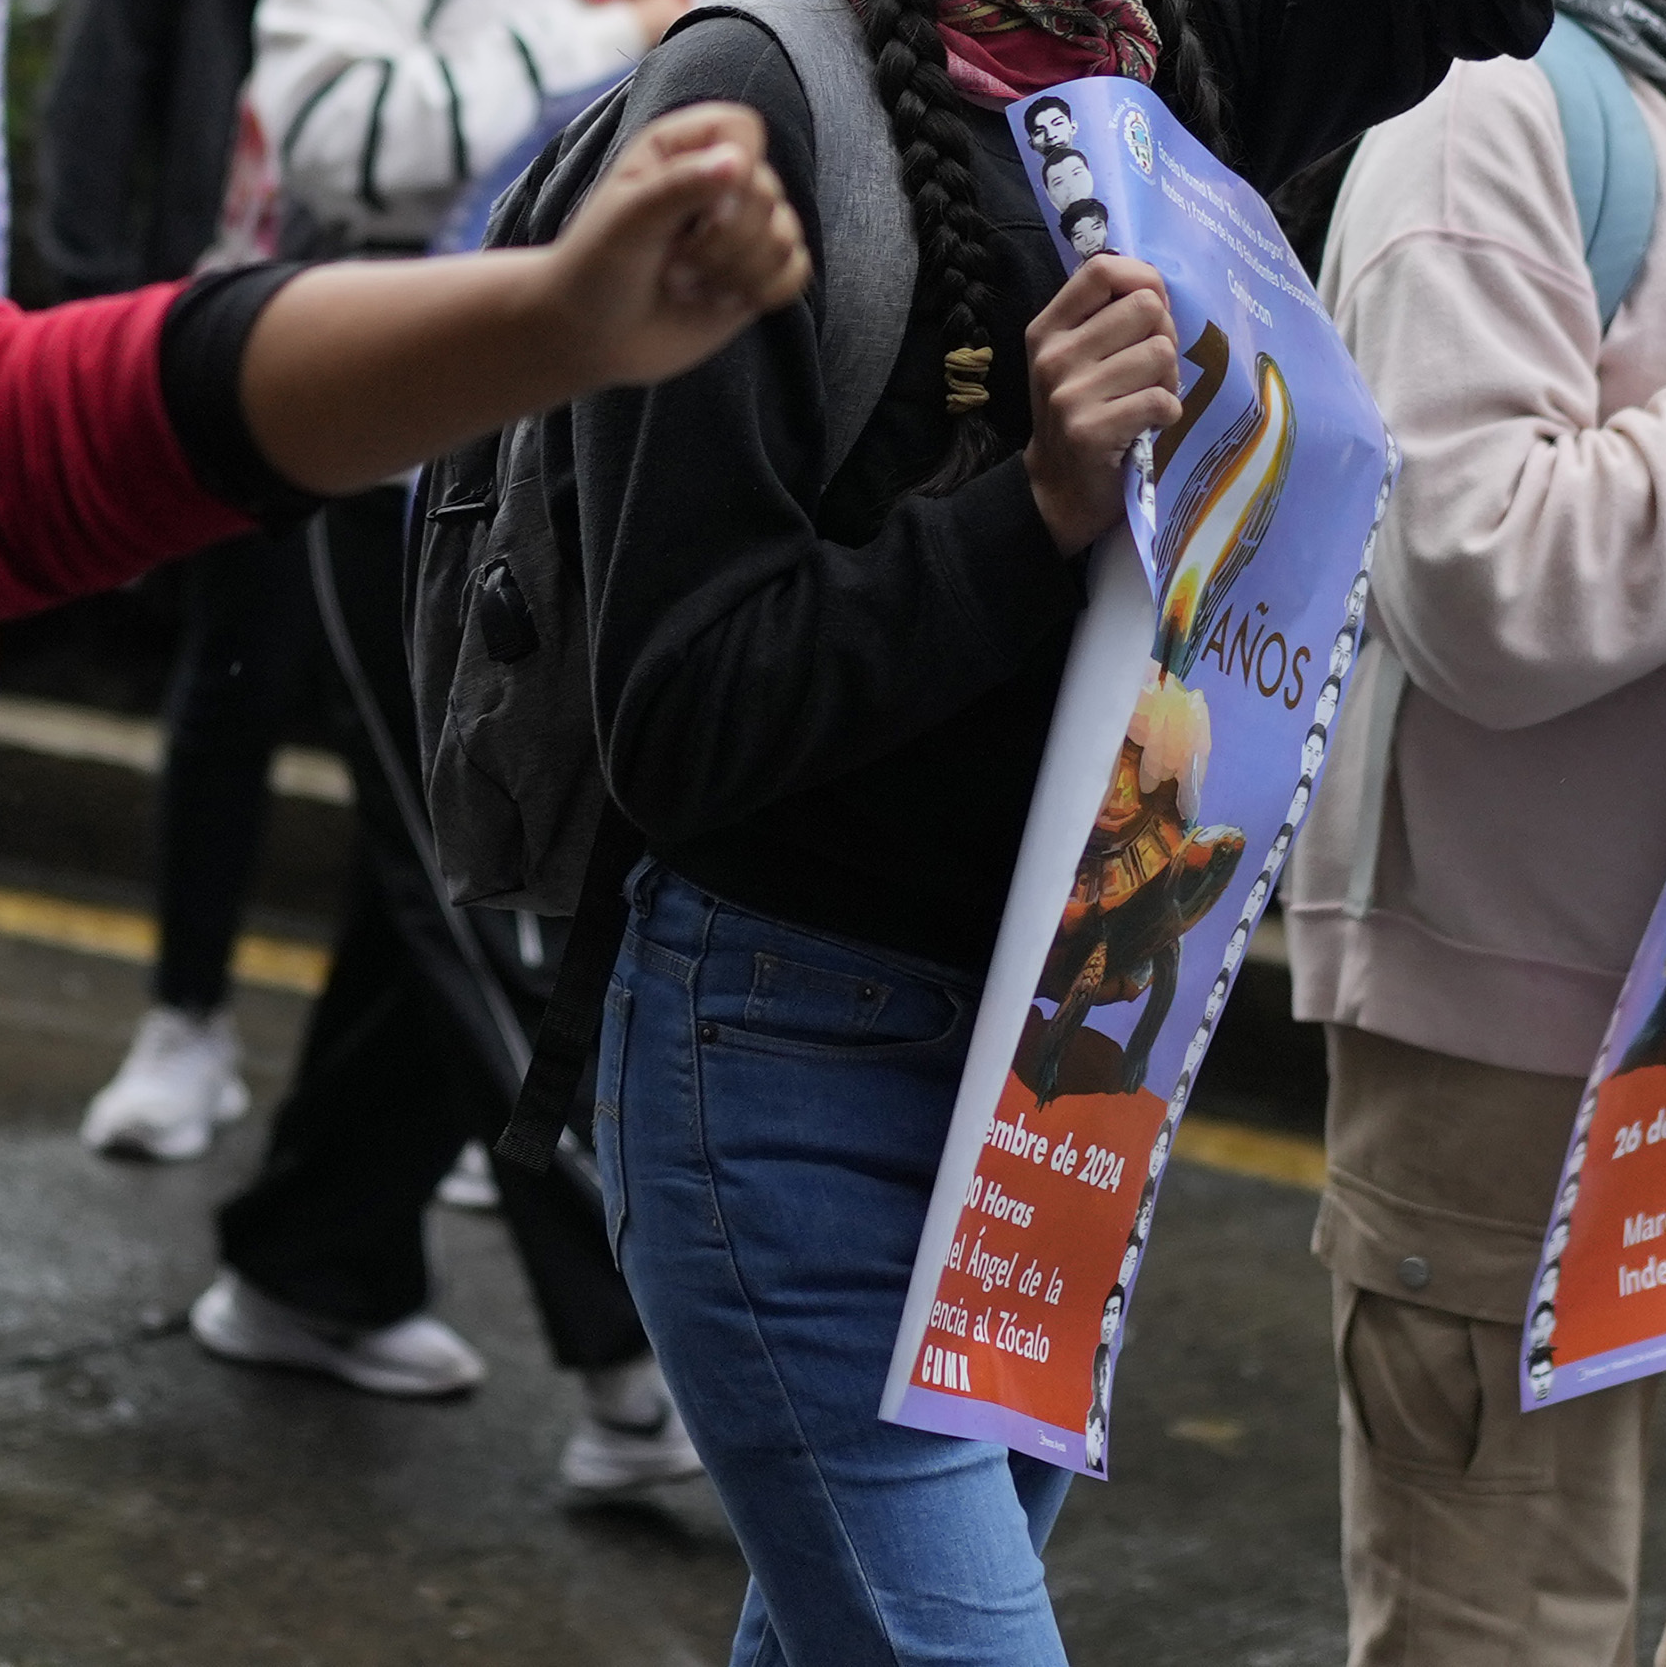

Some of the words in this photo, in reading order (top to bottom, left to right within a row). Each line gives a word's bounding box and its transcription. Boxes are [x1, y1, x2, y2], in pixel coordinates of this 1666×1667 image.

[1227, 268, 1273, 329] Convocan
[1201, 601, 1311, 711] AÑOS
[1050, 1131, 1078, 1176] de
[1077, 1144, 1126, 1193] 2024
[1611, 1120, 1643, 1161] 26
[980, 1180, 1035, 1229] Horas
[966, 1225, 1019, 1292] Ángel
[1018, 1259, 1042, 1298] de
[1044, 1266, 1064, 1305] la
[973, 1306, 992, 1345] al
[995, 1310, 1050, 1364] Zócalo
[921, 1344, 971, 1393] CDMX
